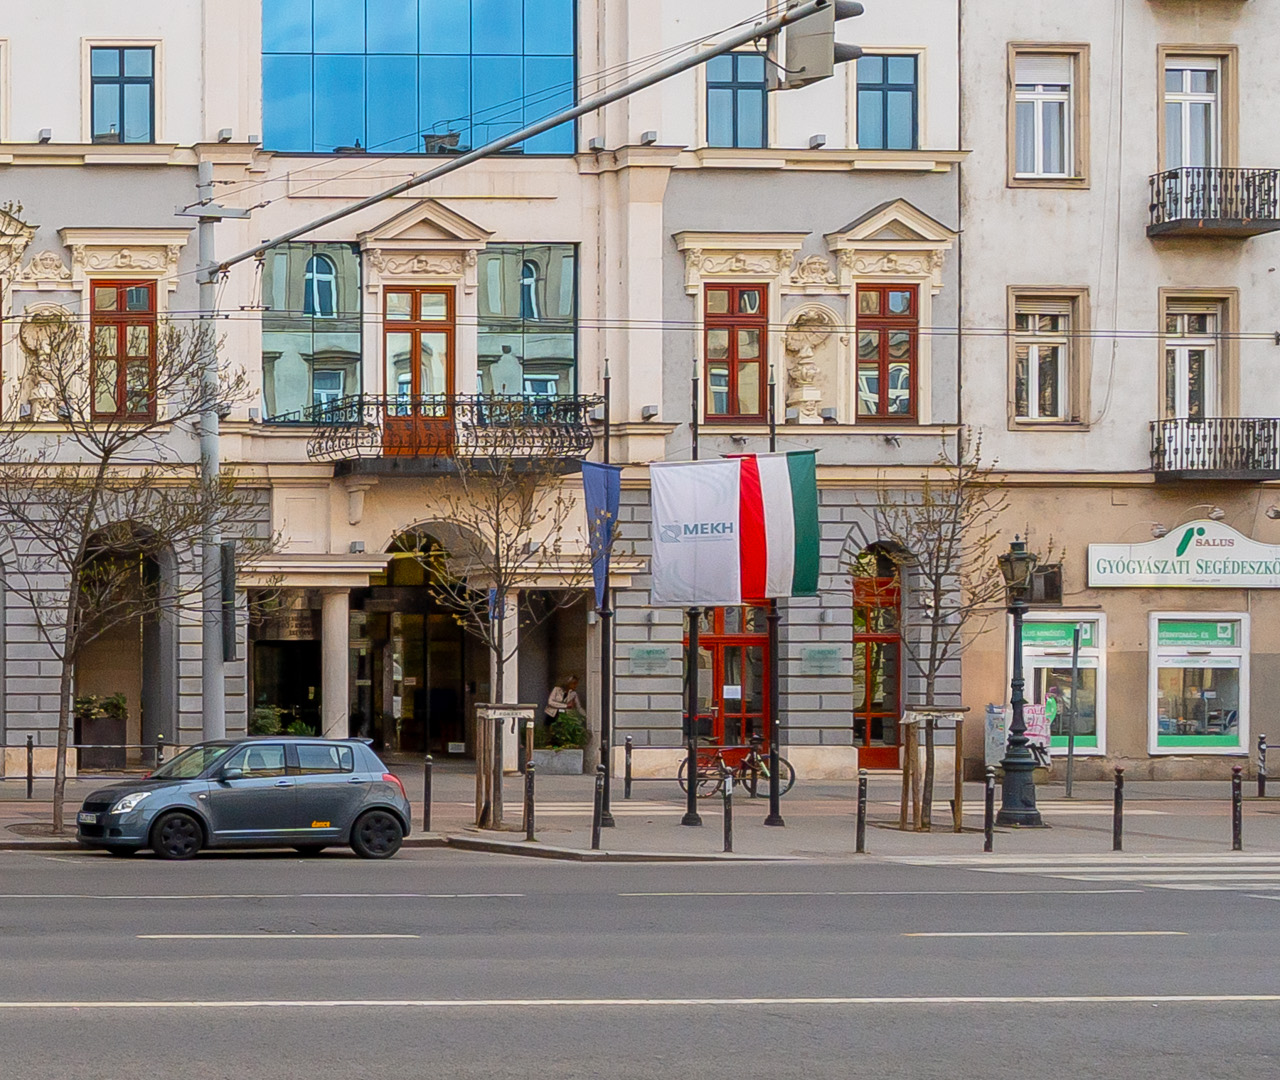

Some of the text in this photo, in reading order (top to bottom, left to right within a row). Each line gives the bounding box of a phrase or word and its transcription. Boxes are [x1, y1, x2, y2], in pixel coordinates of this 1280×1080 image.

[683, 522, 734, 535] MEKH
[1195, 538, 1235, 547] SALUS
[1096, 556, 1190, 575] GYÓGYÁSZATI
